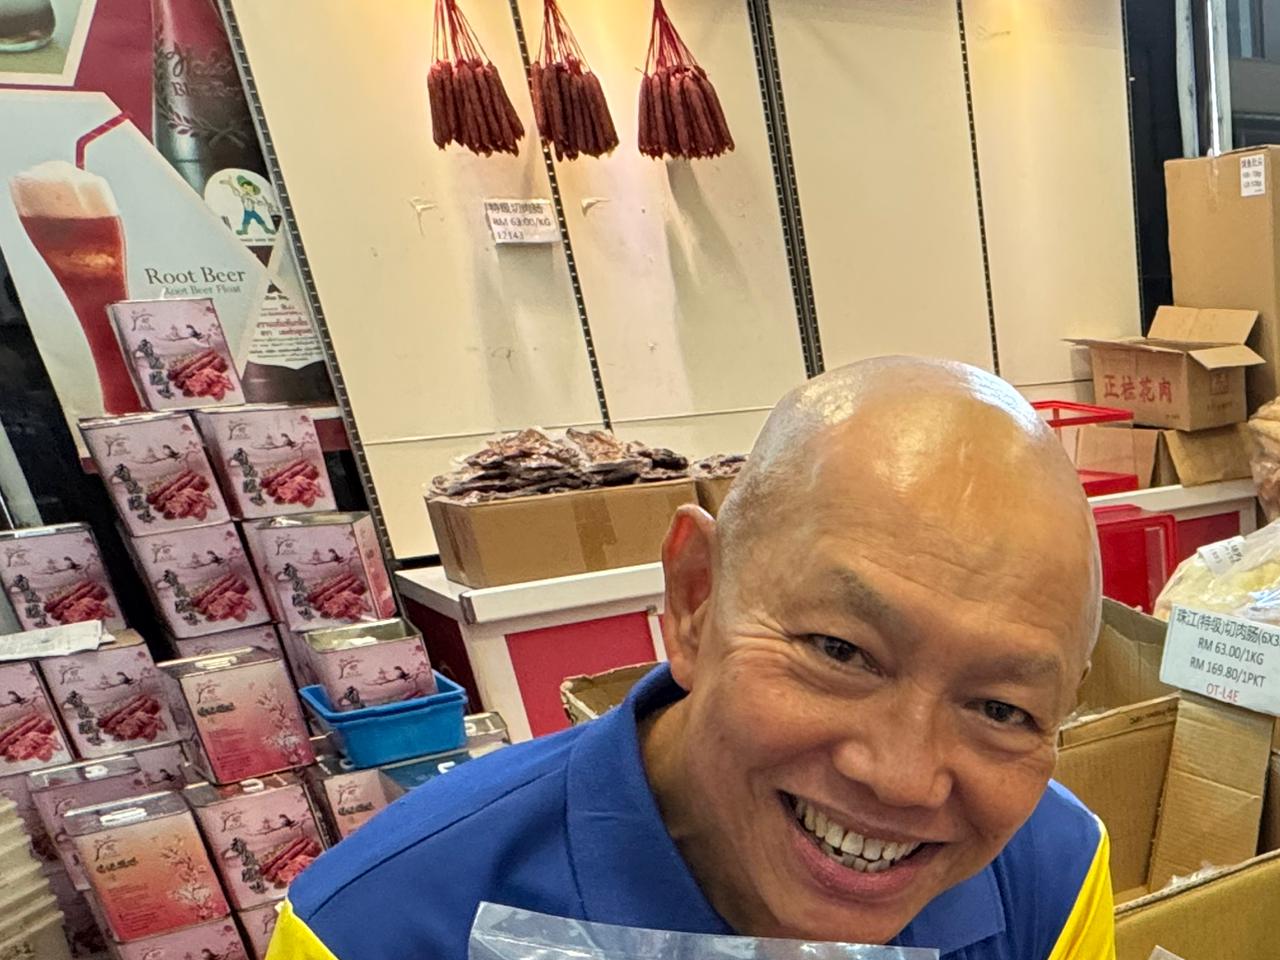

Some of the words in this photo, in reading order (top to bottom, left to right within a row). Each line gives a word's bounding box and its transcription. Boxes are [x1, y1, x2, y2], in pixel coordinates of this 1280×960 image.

[145, 268, 197, 286] Root
[200, 266, 246, 284] Beer
[190, 286, 214, 296] Beer
[216, 284, 242, 296] Float
[1198, 637, 1214, 649] RM
[1215, 641, 1265, 666] 63.00/1KG
[1190, 656, 1205, 671] RM
[1207, 661, 1267, 688] 169.80/1PKT
